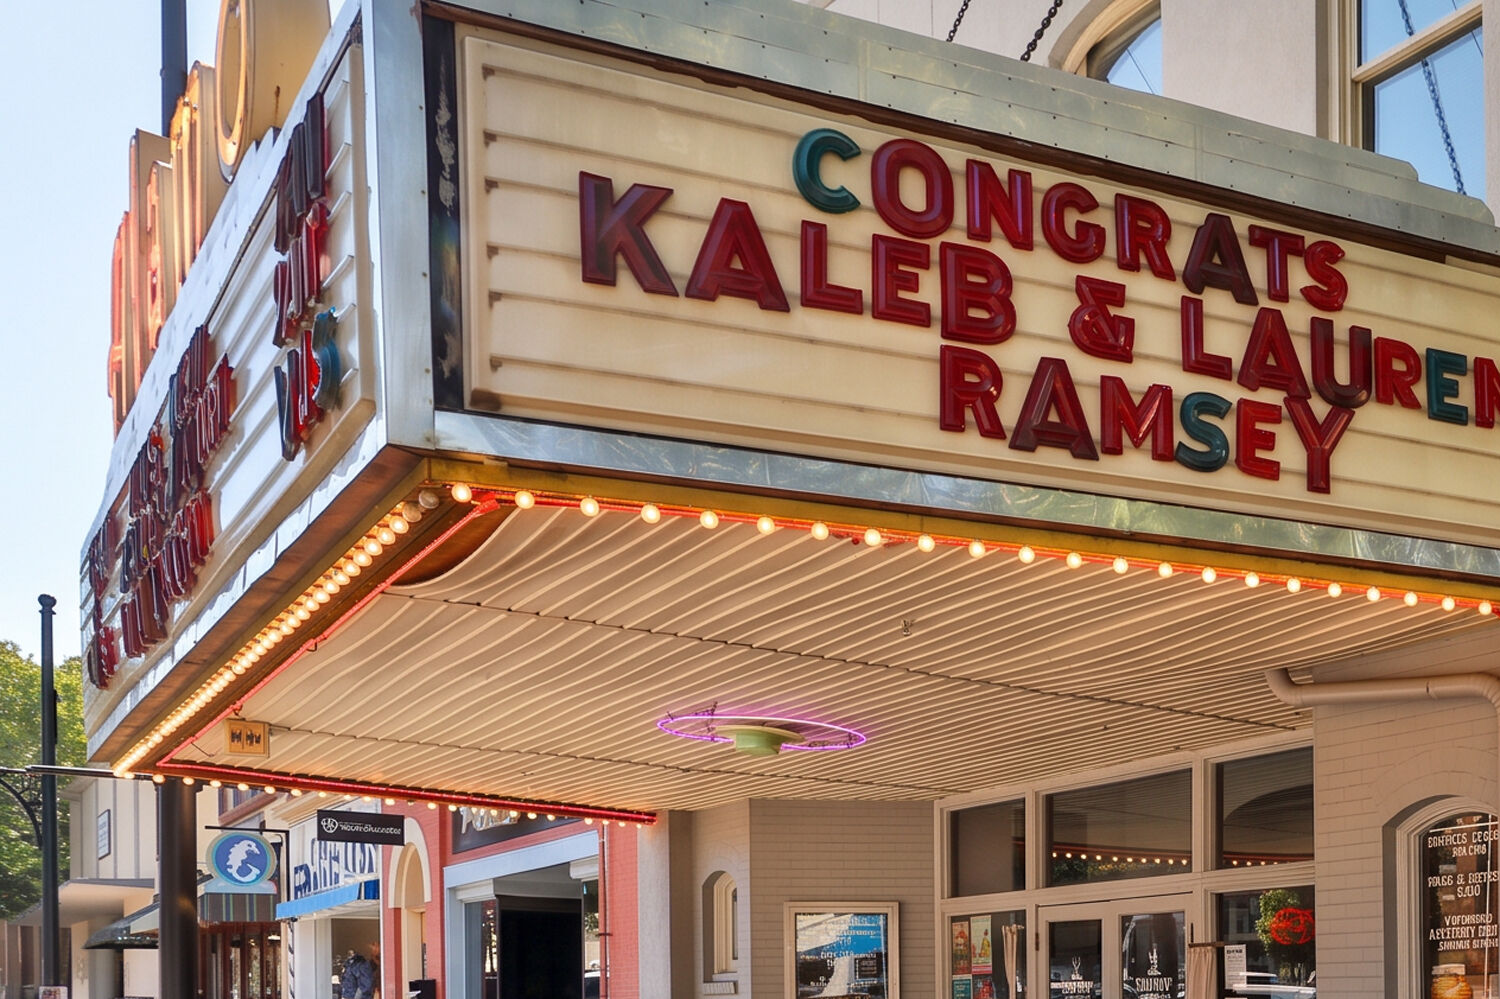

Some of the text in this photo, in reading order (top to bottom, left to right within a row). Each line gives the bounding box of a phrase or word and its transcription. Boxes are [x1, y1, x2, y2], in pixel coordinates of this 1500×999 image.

[578, 169, 1018, 345] KALEB
[1068, 274, 1135, 365] &
[793, 128, 1347, 311] CONGRATS
[939, 343, 1356, 494] RAMSEY
